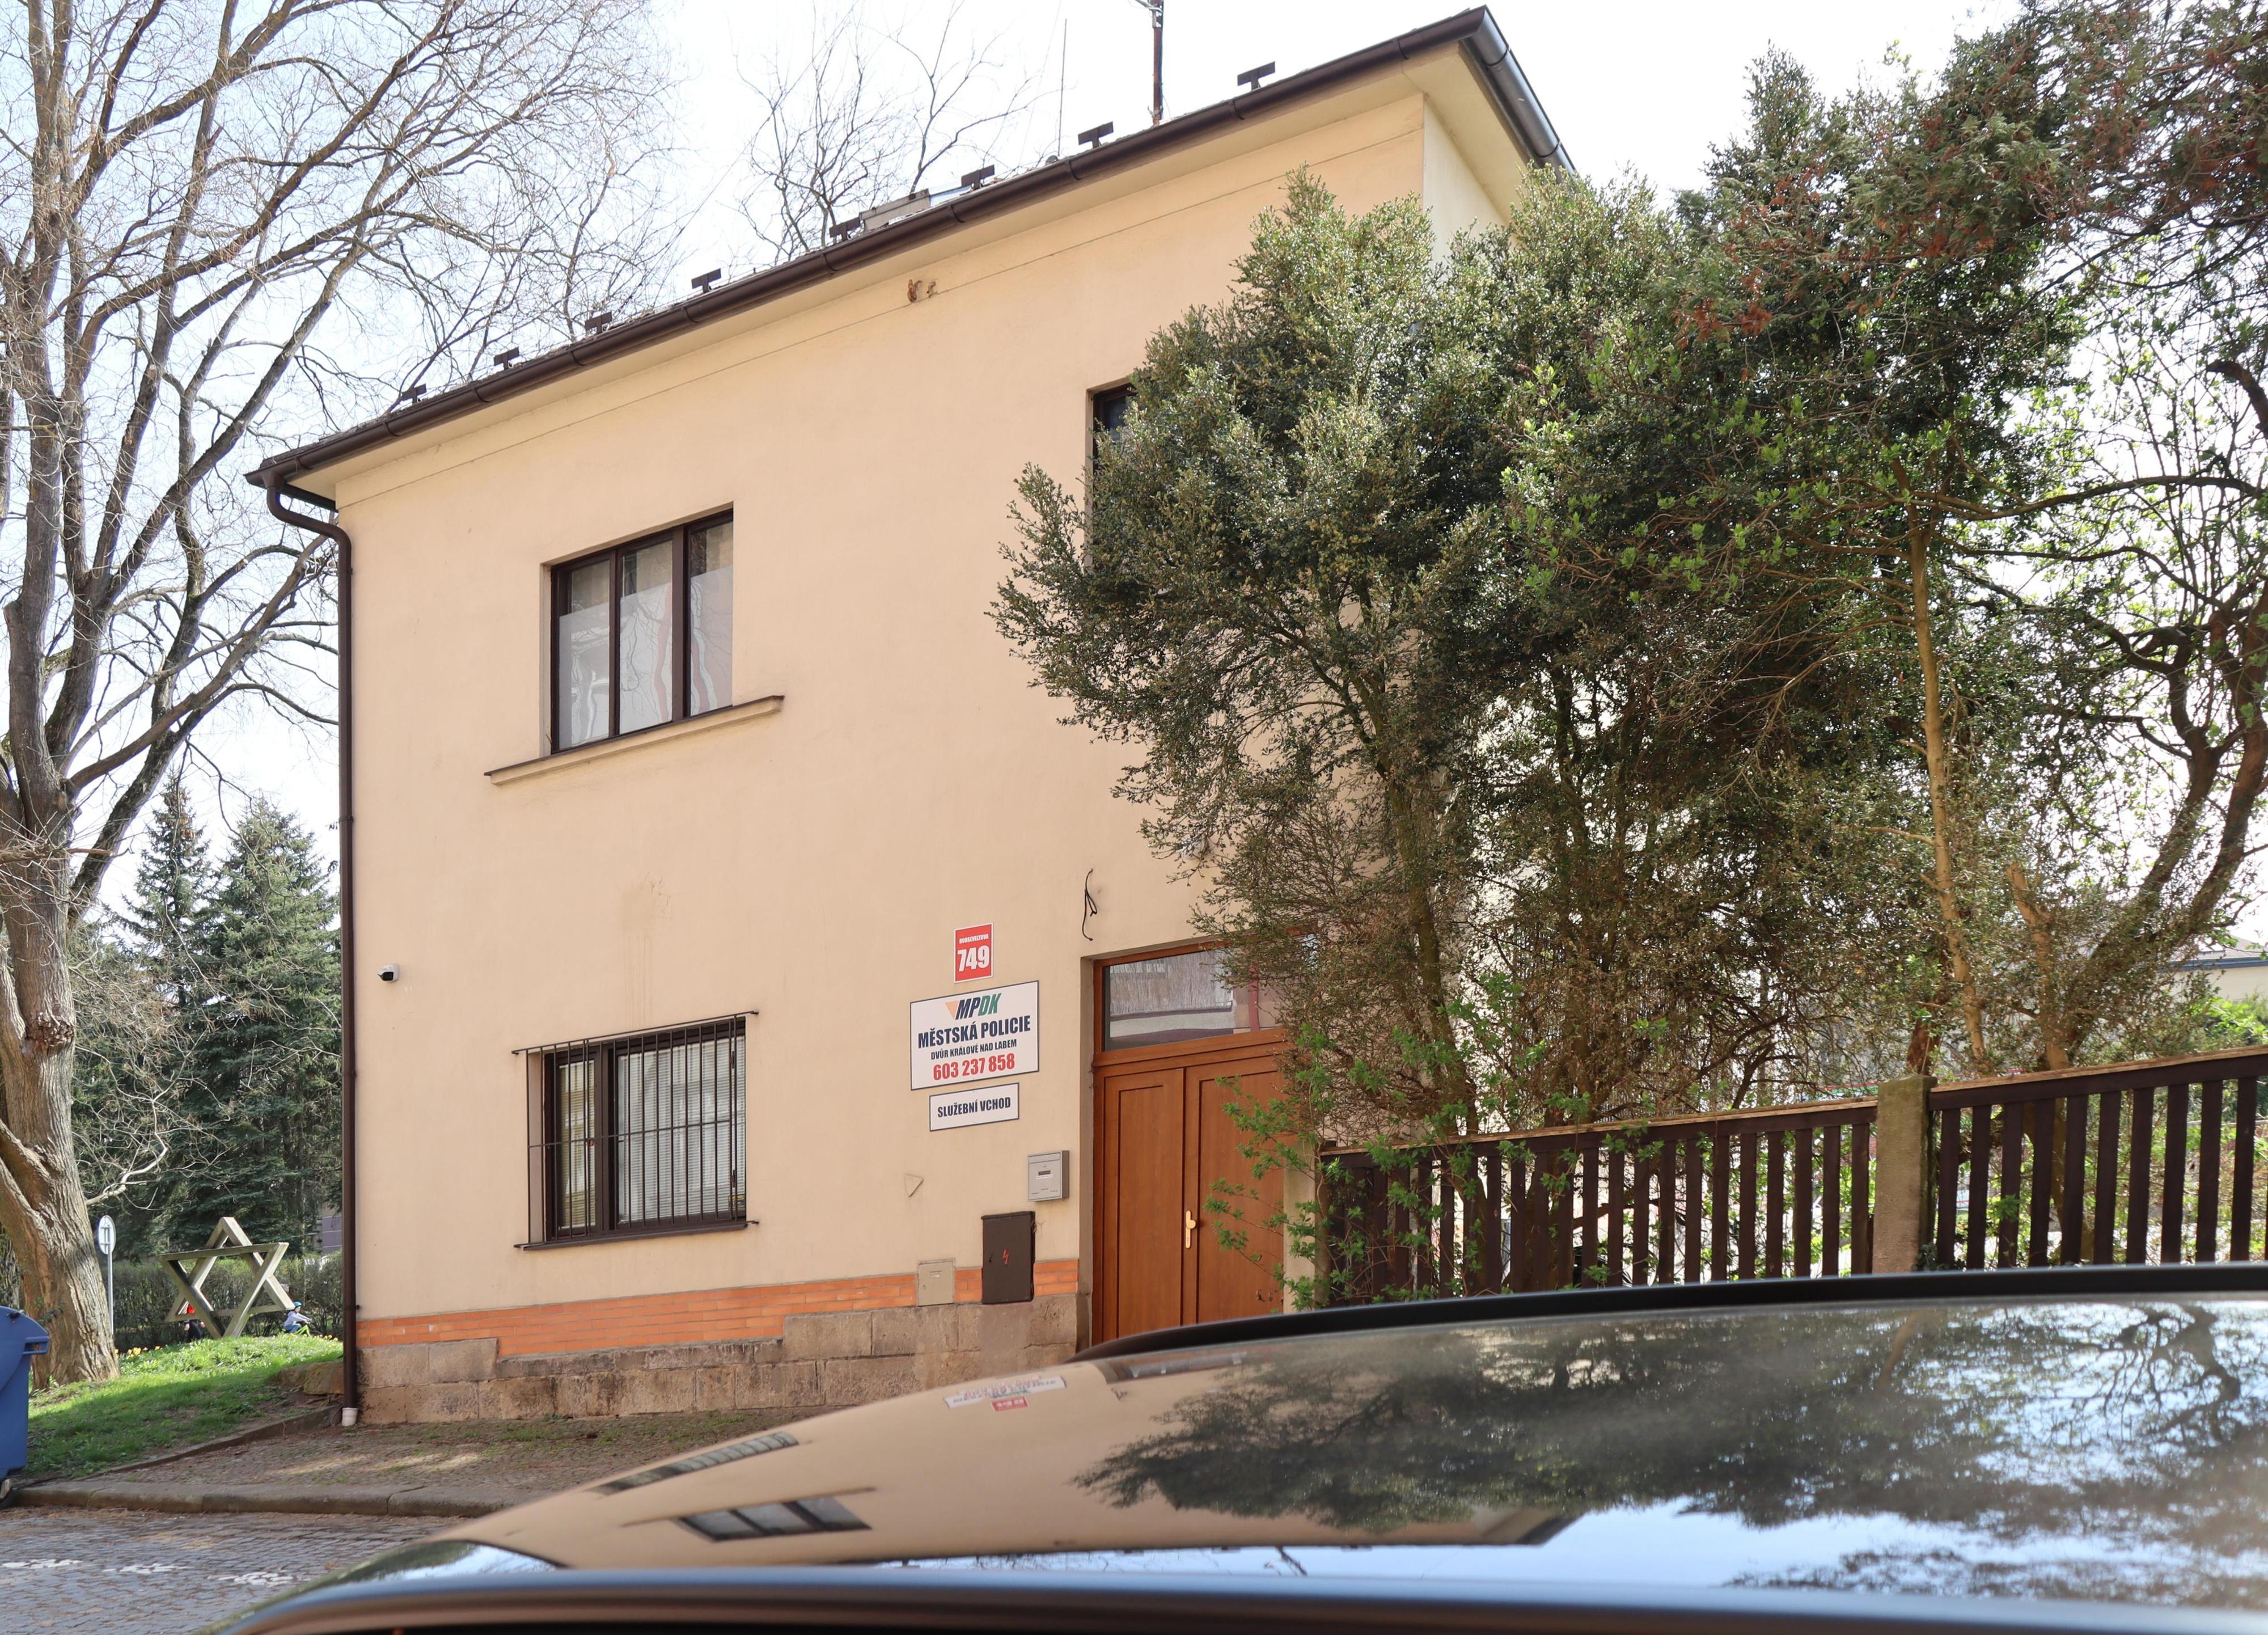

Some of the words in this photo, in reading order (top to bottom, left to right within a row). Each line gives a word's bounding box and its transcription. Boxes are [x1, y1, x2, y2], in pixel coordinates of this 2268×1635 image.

[959, 933, 989, 944] ROOSEVELTOVA
[957, 945, 989, 971] 749
[955, 993, 1002, 1020] MPDK
[918, 1021, 978, 1049] MĚSTSKÁ
[981, 1015, 1031, 1038] POLICIE
[931, 1049, 949, 1060] DVŮR
[950, 1043, 979, 1057] KRÁLOVÉ
[980, 1042, 993, 1053] NAD
[995, 1038, 1017, 1050] LABEM
[933, 1061, 959, 1081] 603
[962, 1057, 985, 1076] 237
[988, 1053, 1015, 1072] 858
[937, 1099, 978, 1118] SLUŽEBNÍ
[980, 1097, 1011, 1112] VCHOD
